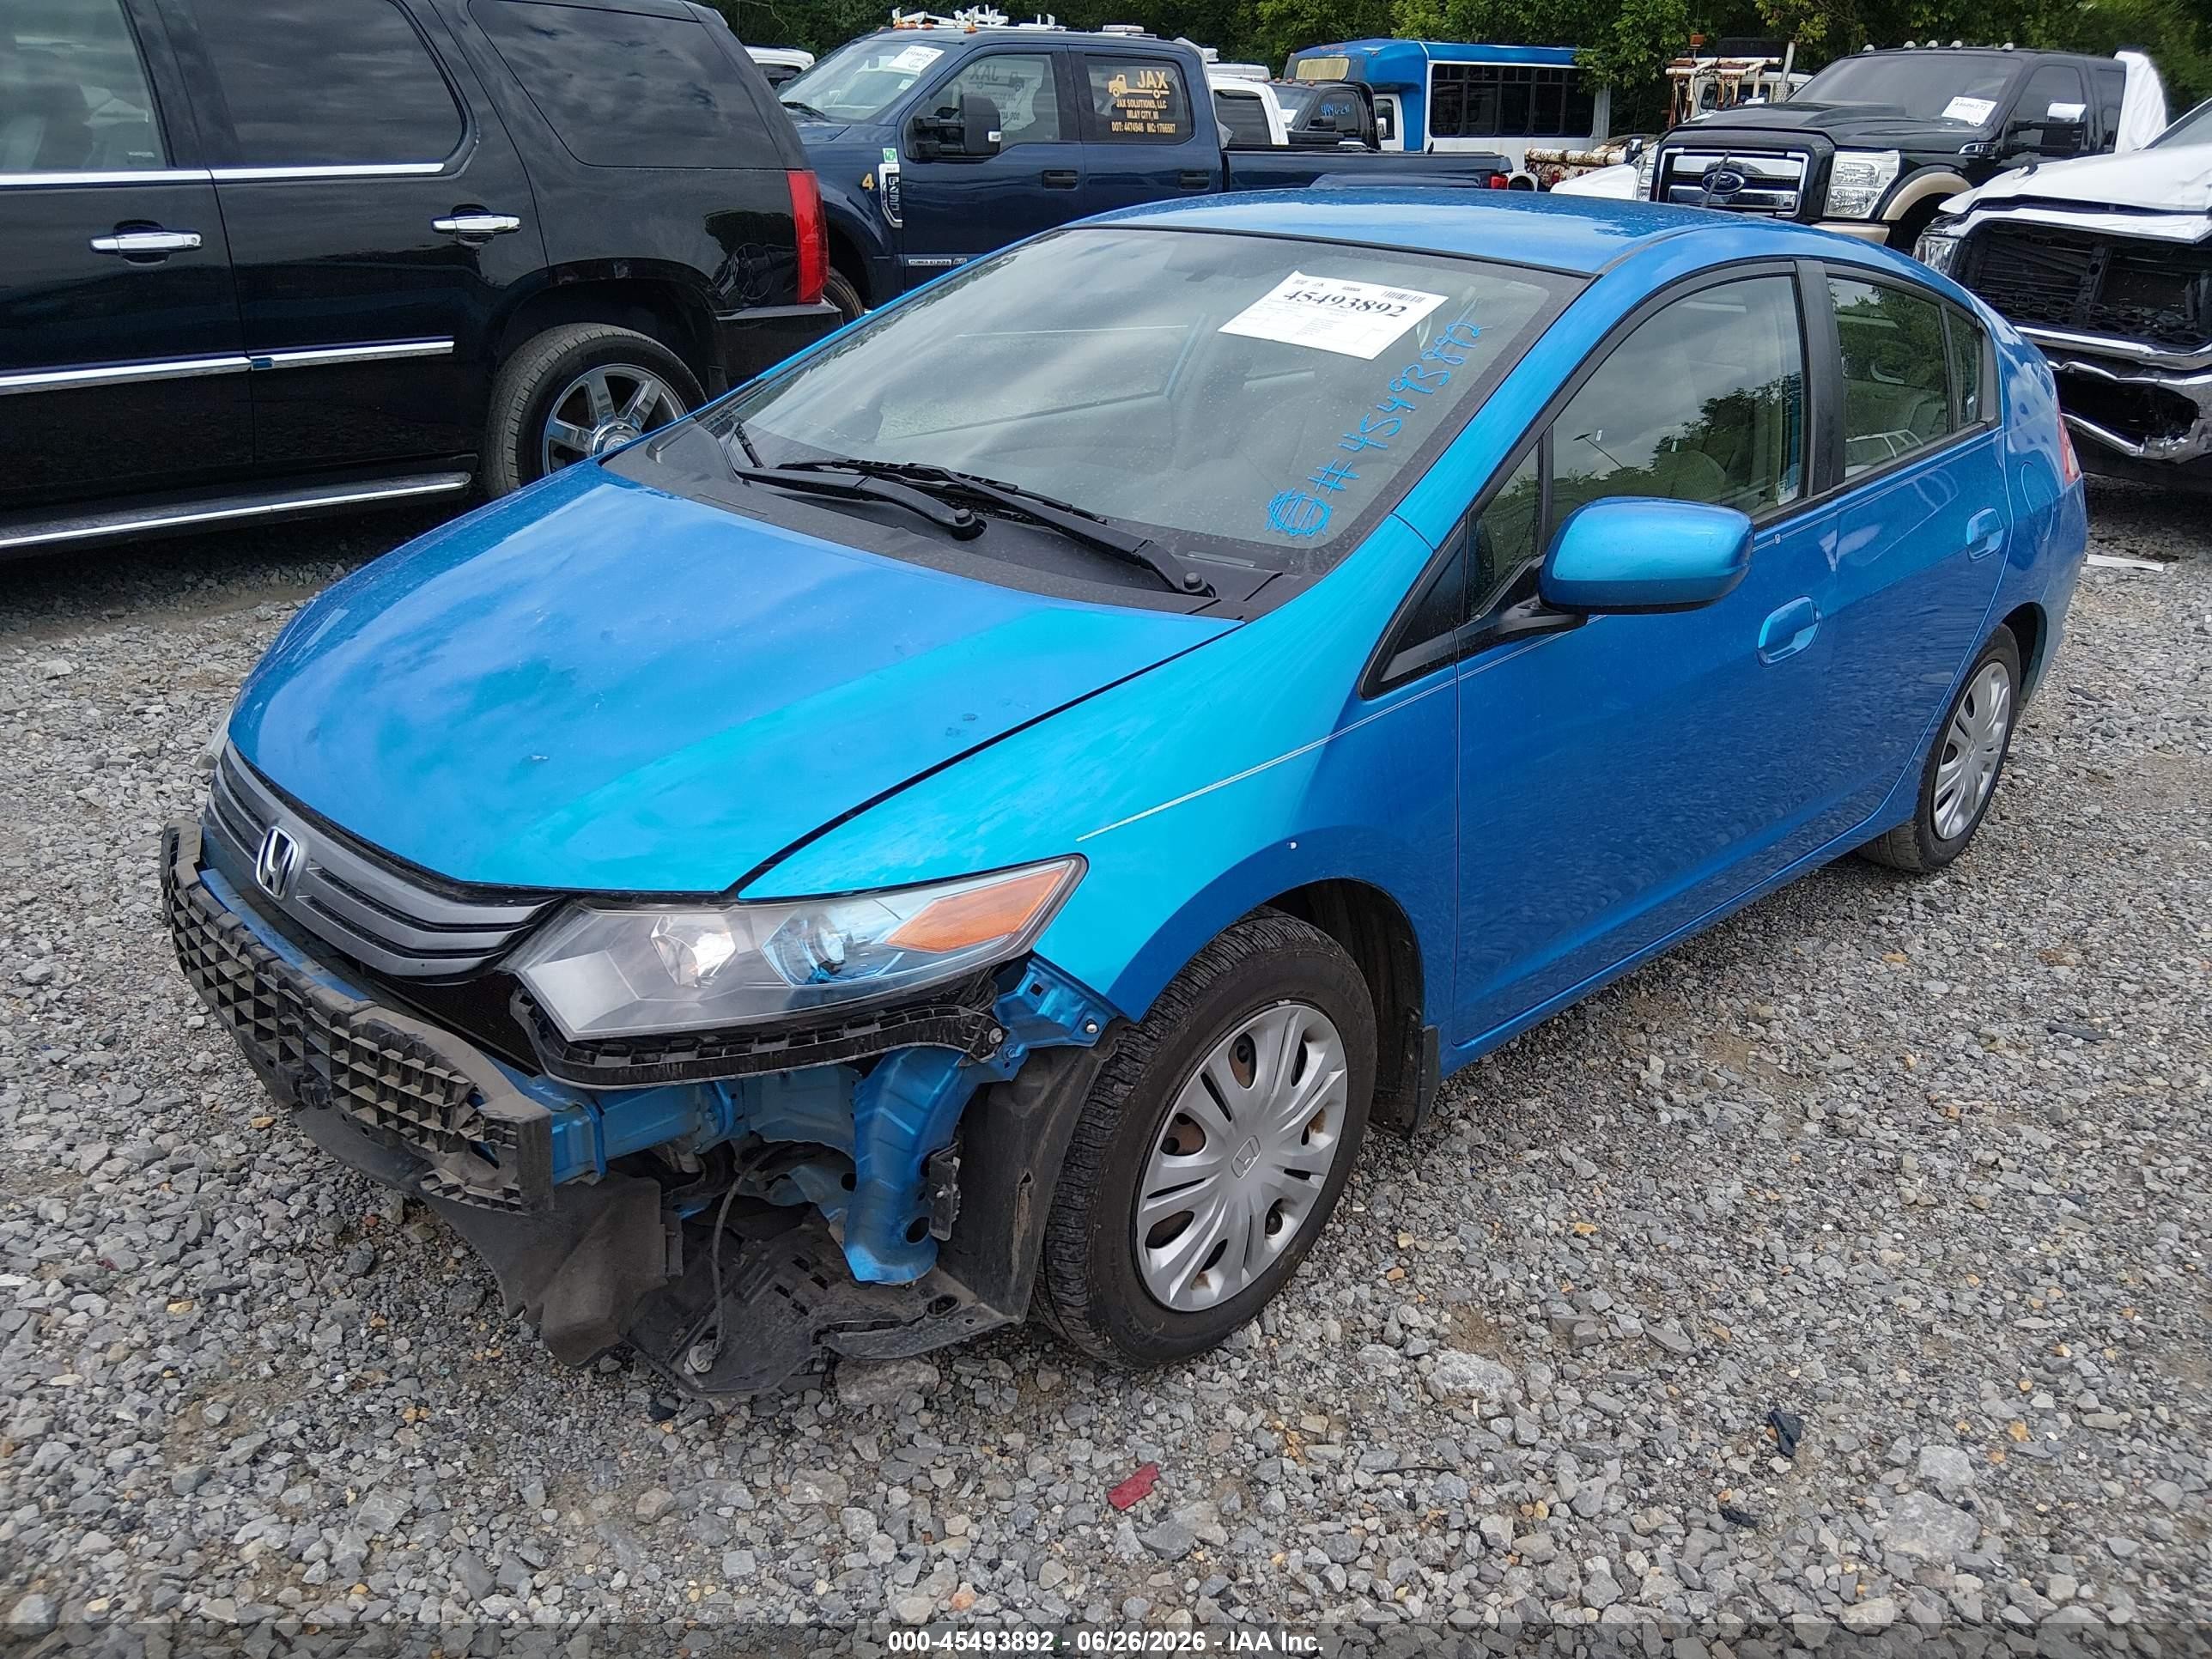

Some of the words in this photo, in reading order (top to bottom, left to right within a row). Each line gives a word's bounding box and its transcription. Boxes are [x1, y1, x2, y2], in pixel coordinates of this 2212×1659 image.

[1137, 70, 1169, 89] JAX
[1116, 99, 1127, 108] JAX
[1127, 99, 1157, 110] SOLUTIONS,
[1157, 100, 1167, 110] LLC
[1140, 111, 1153, 121] CITY,
[1111, 121, 1123, 132] DOT:
[1146, 123, 1157, 133] MC:
[861, 173, 874, 191] 4
[1284, 289, 1407, 318] 45493892
